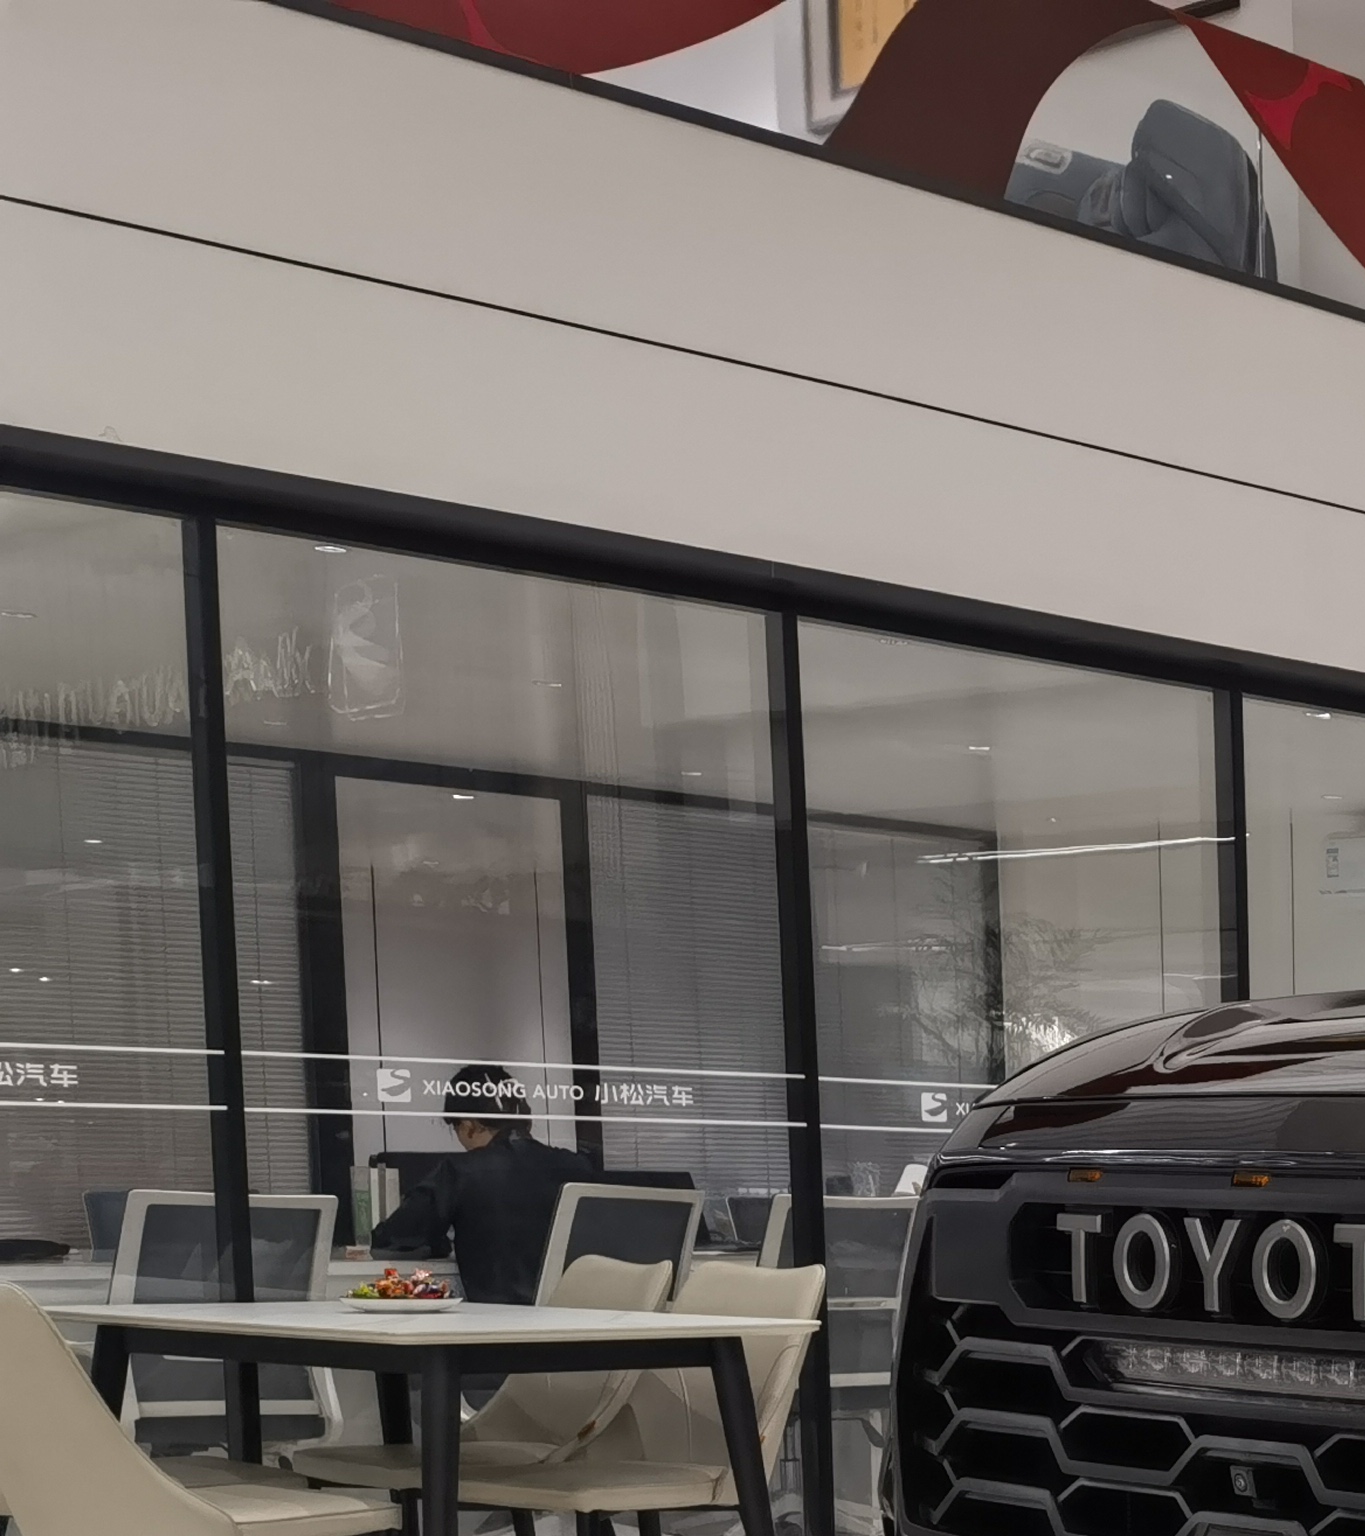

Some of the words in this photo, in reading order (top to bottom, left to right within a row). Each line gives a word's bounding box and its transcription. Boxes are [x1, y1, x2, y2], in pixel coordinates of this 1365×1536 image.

[423, 1080, 526, 1098] XIAOSONG
[532, 1084, 585, 1100] AUTO
[594, 1083, 694, 1106] 小松汽车
[955, 1102, 976, 1116] XI
